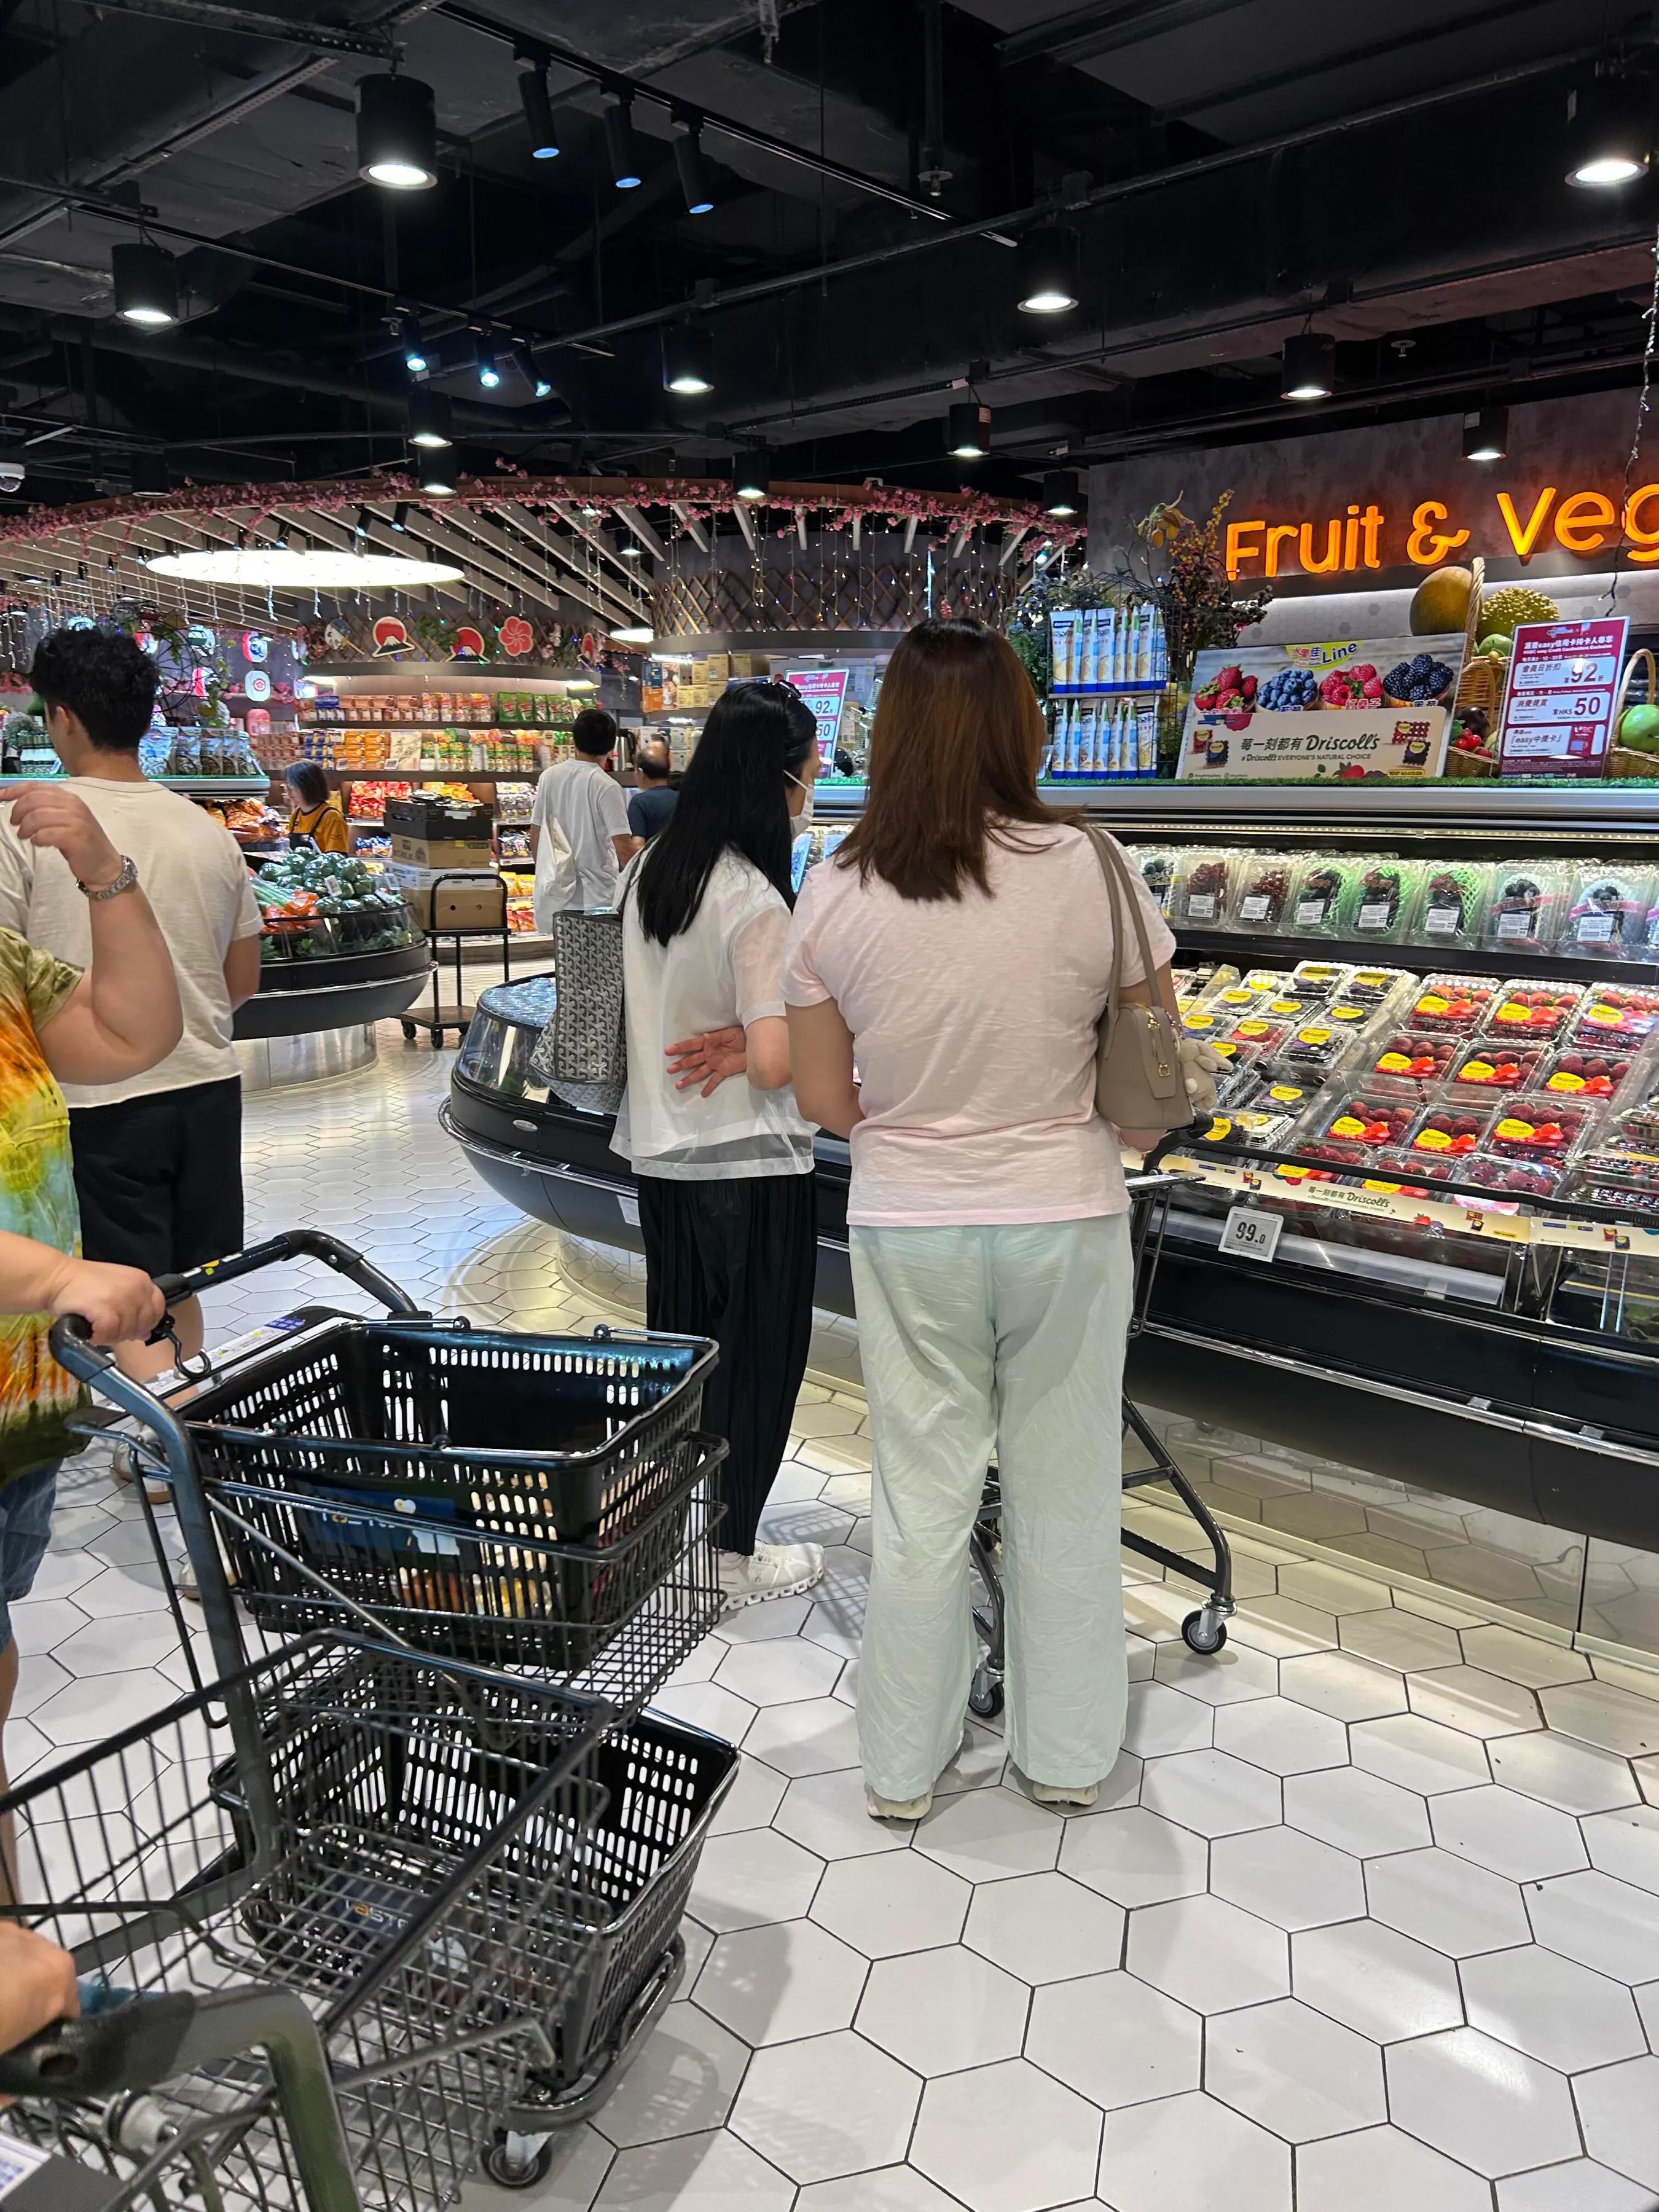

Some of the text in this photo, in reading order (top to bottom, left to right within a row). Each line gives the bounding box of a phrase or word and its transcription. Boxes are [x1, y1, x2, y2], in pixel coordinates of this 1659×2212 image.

[1226, 504, 1384, 581] Fruit
[1406, 501, 1470, 565] &
[1322, 643, 1357, 664] Line
[1574, 696, 1601, 716] 50
[1241, 733, 1381, 751] 莓一刻都有 Driscoll's
[1347, 1192, 1390, 1207] Driscoll's
[1236, 1222, 1266, 1244] 99.0
